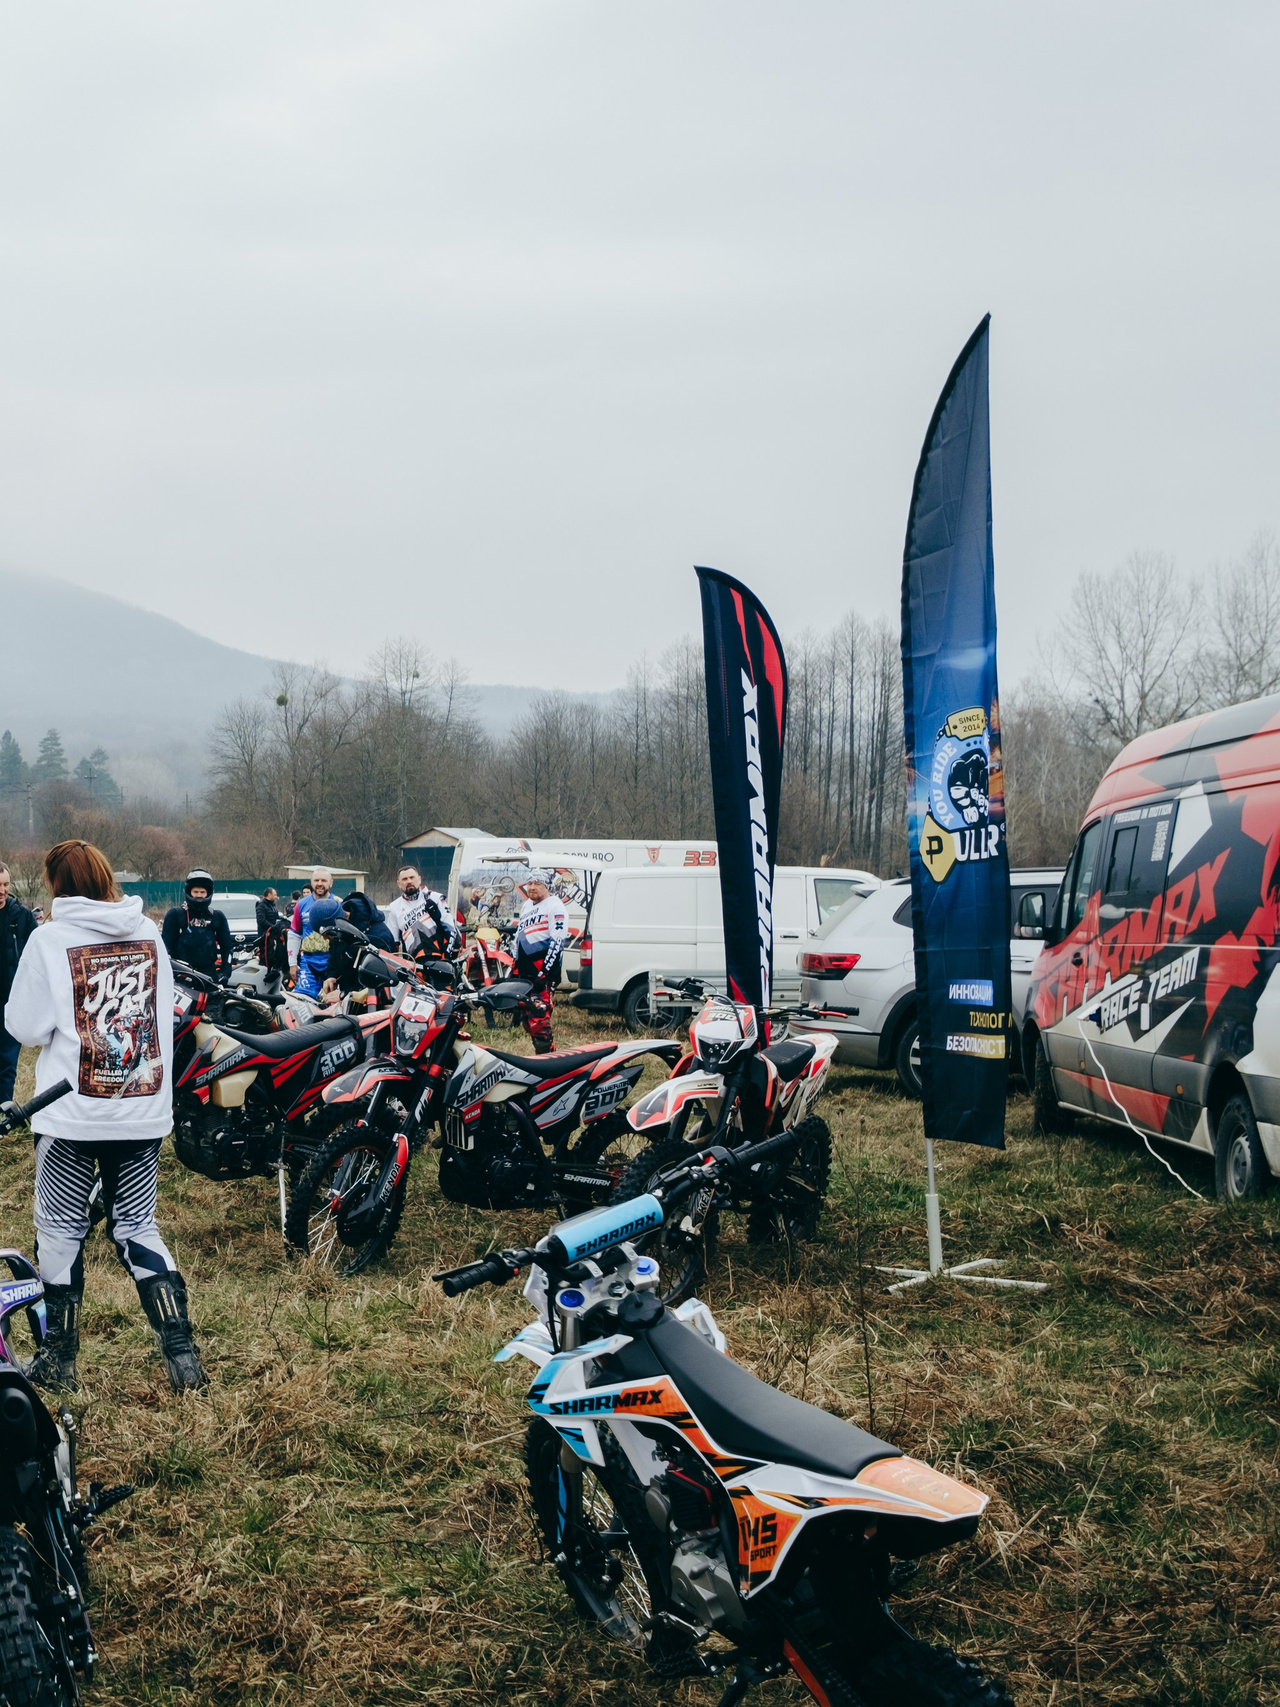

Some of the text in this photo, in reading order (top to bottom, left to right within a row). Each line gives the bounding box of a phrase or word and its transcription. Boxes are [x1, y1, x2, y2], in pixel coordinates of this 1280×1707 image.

[958, 714, 980, 725] SINCE
[962, 724, 981, 733] 2014
[932, 741, 958, 827] YOU RIDE
[1113, 803, 1174, 825] FREEDOM IN MOTION
[683, 850, 717, 867] 33
[404, 909, 428, 931] DESAN
[518, 914, 545, 932] SANT
[1034, 847, 1231, 1021] SHARMAX
[82, 959, 155, 1013] JUST
[1100, 946, 1200, 1034] RACE TEAM
[96, 987, 157, 1034] CAT
[946, 1035, 1006, 1055] БЕЗОПАСНОСТ
[194, 1048, 249, 1087] SHARMAX
[320, 1042, 356, 1072] 300
[94, 1068, 123, 1076] FUELLED
[322, 1067, 336, 1078] AIR
[454, 1062, 511, 1108] SHARMAX
[464, 1108, 481, 1120] KENDA
[379, 1163, 402, 1203] KENDA
[563, 1173, 611, 1187] SHARMAX
[696, 1187, 711, 1217] KEN
[575, 1211, 656, 1257] SHARMAX
[549, 1390, 665, 1415] SHARMAX
[750, 1545, 778, 1562] SPORT
